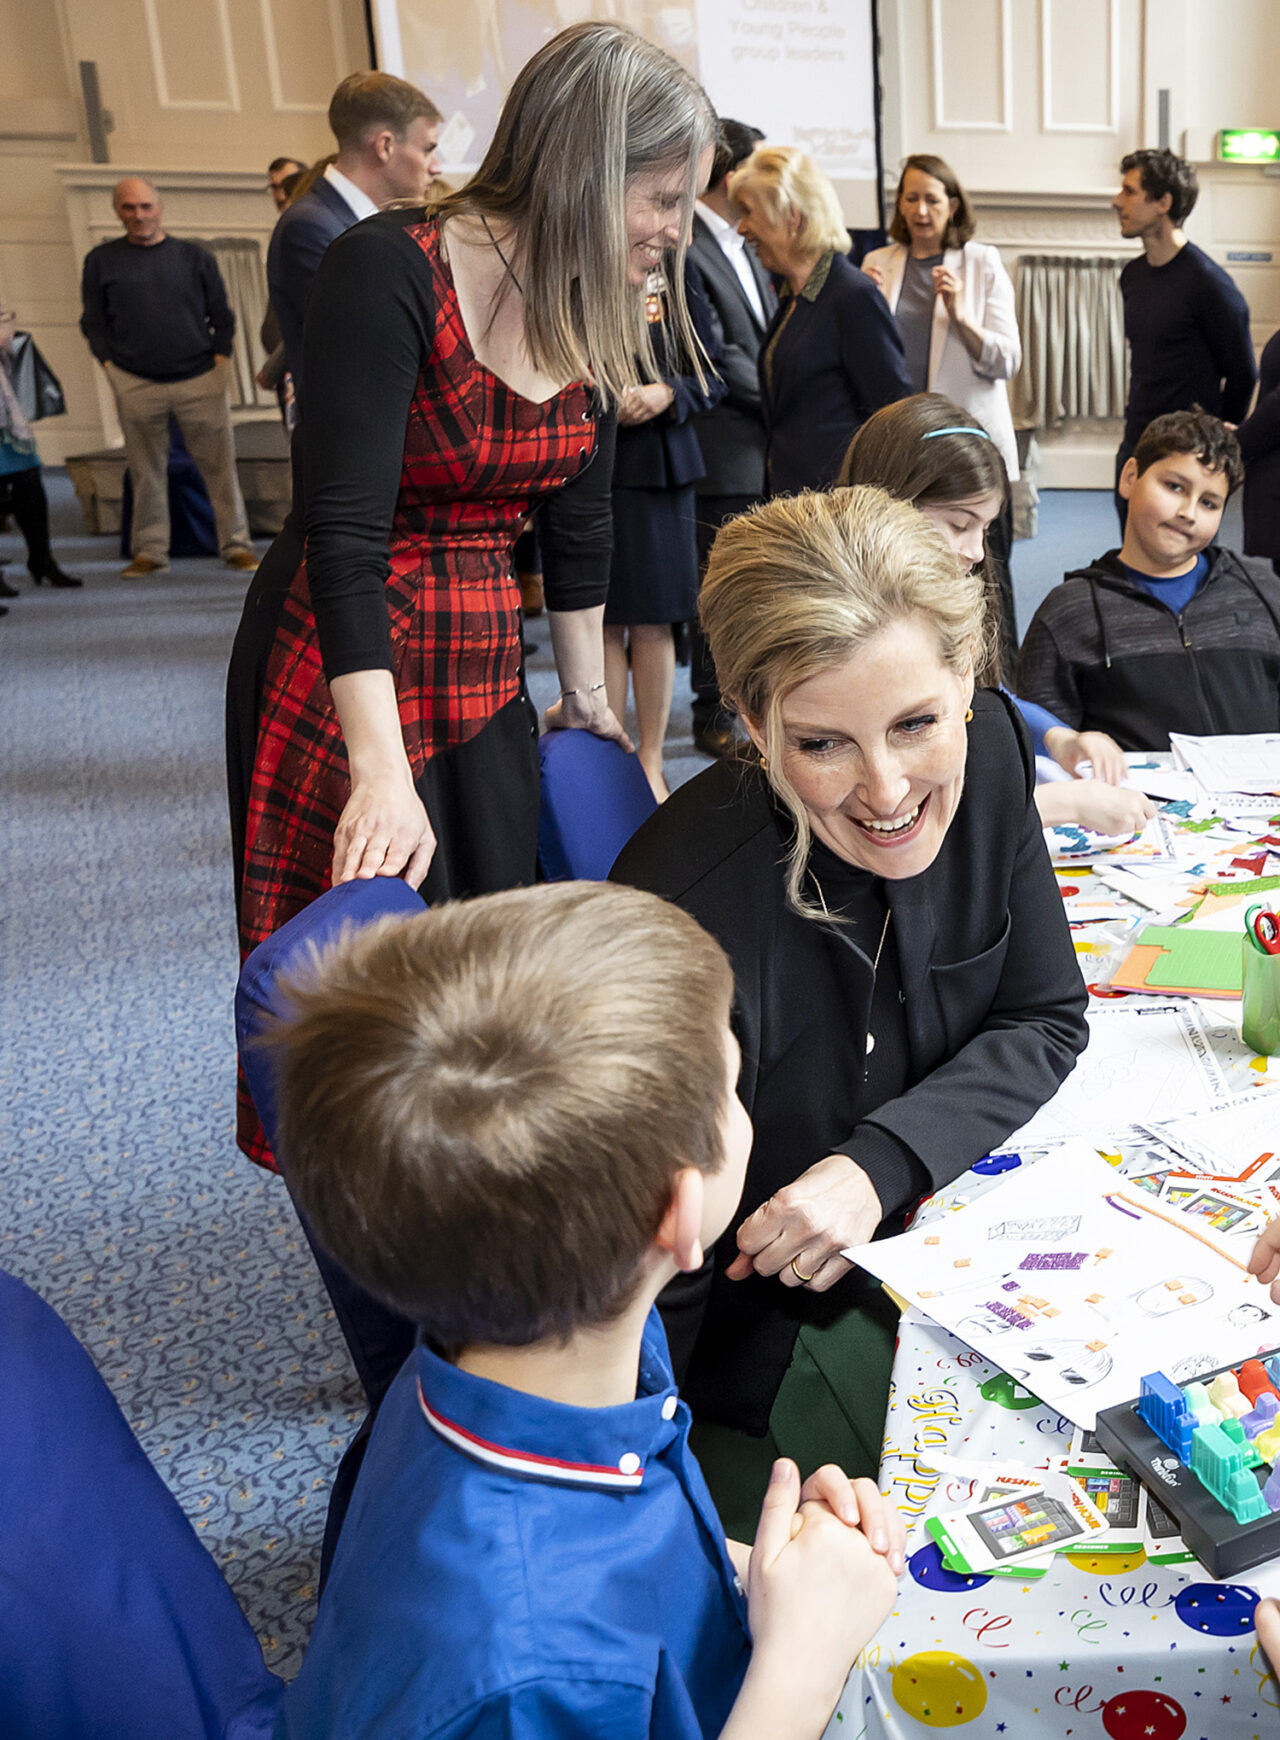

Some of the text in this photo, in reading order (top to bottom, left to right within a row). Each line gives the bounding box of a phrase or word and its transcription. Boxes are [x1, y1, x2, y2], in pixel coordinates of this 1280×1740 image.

[728, 17, 846, 40] Young People
[731, 45, 847, 62] group leaders
